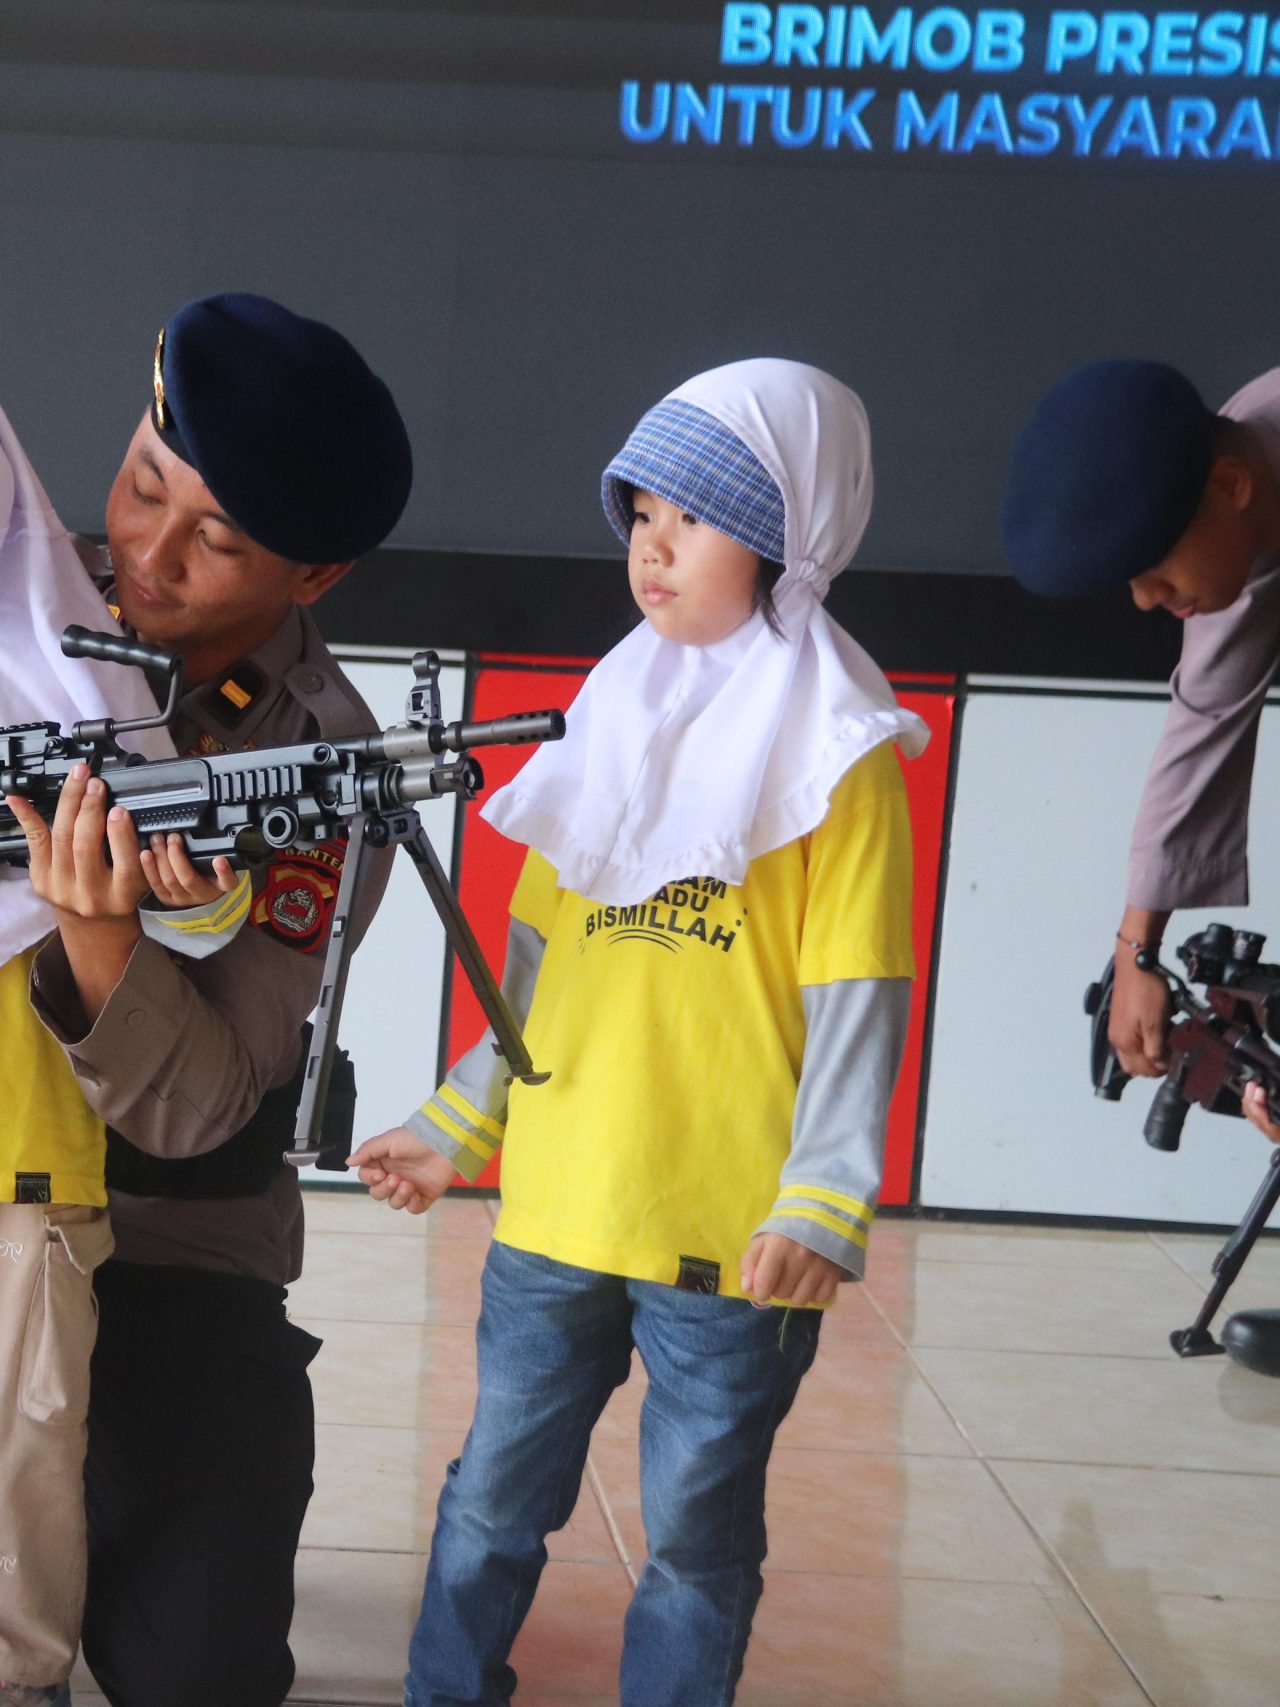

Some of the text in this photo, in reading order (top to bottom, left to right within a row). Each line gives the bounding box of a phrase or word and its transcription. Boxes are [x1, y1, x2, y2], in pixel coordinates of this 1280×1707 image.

[719, 1, 1280, 76] BRIMOB PRESI
[620, 80, 1280, 160] UNTUK MASYARA
[586, 903, 737, 953] BISMILLAH
